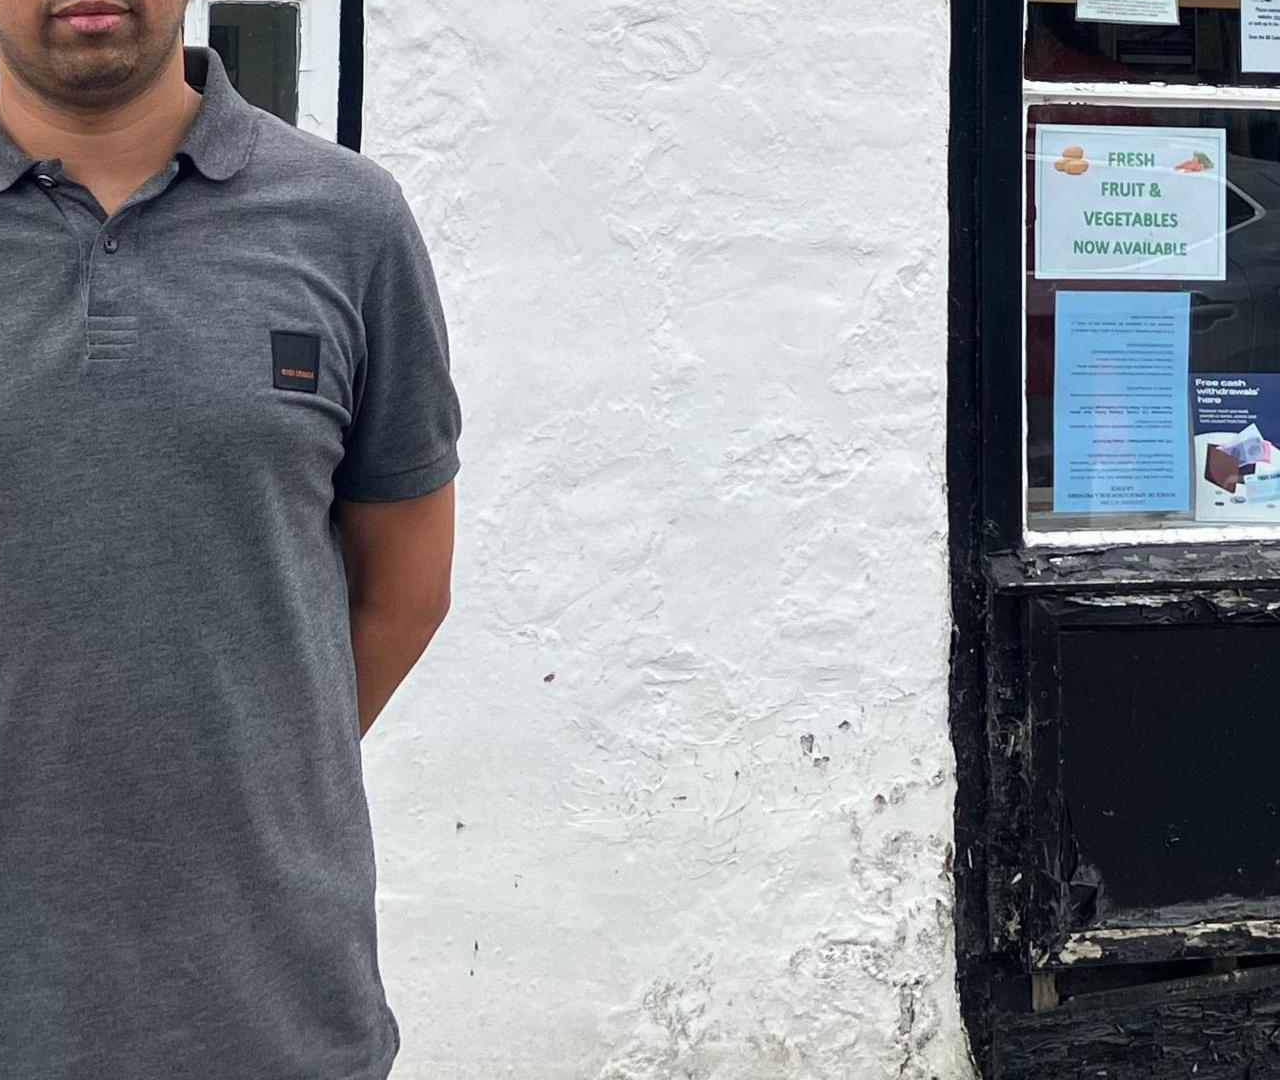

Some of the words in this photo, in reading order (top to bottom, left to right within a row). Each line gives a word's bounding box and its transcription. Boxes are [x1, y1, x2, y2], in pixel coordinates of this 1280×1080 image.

[1108, 152, 1155, 167] FRESH
[1101, 182, 1145, 197] FRUIT
[1149, 182, 1162, 198] &
[1084, 212, 1178, 228] VEGETABLES
[1074, 240, 1110, 254] NOW
[1113, 242, 1187, 256] AVAILABLE
[1196, 378, 1218, 386] Free
[1220, 379, 1246, 387] cash
[1198, 396, 1222, 404] here
